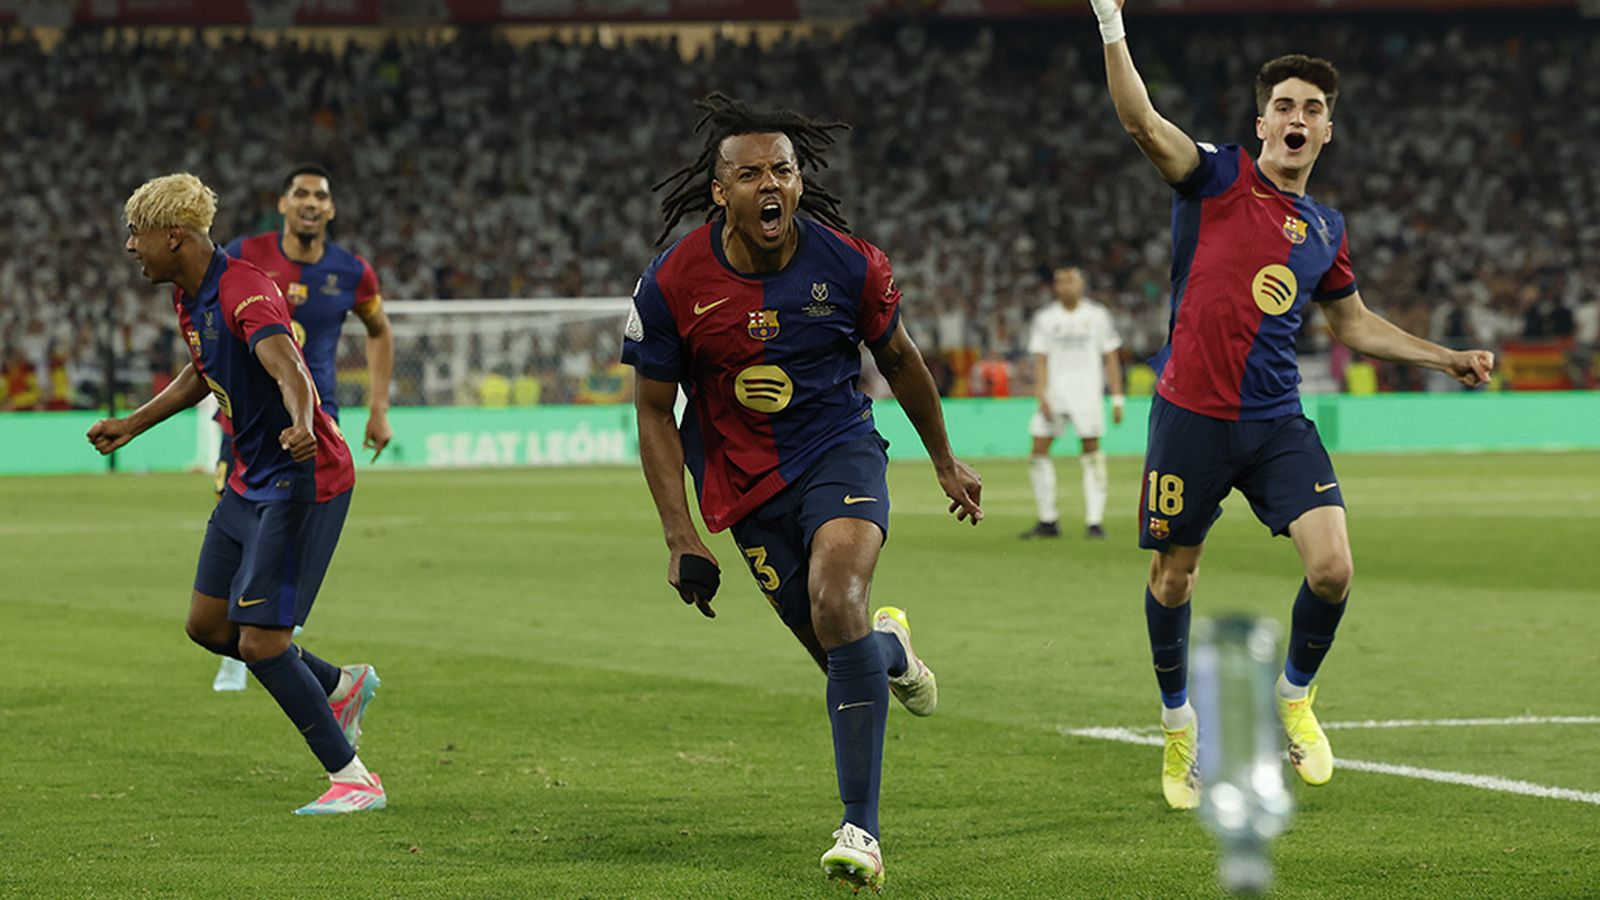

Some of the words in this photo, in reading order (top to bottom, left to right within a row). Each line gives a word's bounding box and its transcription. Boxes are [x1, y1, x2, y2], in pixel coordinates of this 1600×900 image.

[426, 431, 519, 466] SEAT
[527, 421, 625, 464] LEÓN
[1148, 470, 1184, 516] 18
